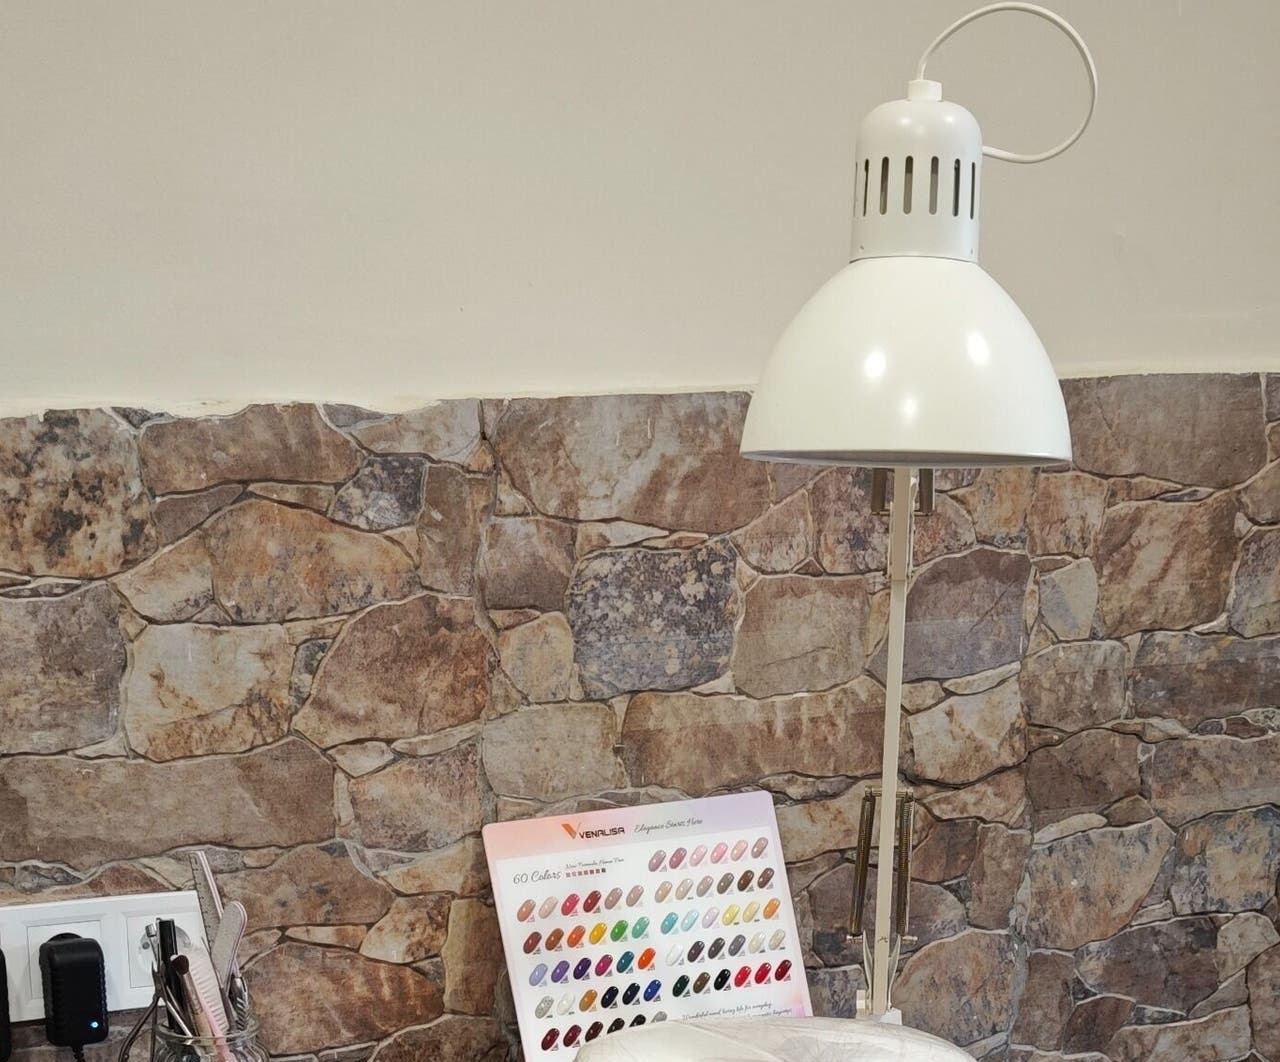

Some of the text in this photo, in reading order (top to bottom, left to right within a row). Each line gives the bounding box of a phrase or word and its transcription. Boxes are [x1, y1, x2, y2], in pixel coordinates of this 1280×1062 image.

[579, 826, 625, 839] VENALISA
[513, 873, 528, 884] 60
[531, 869, 562, 882] Colors
